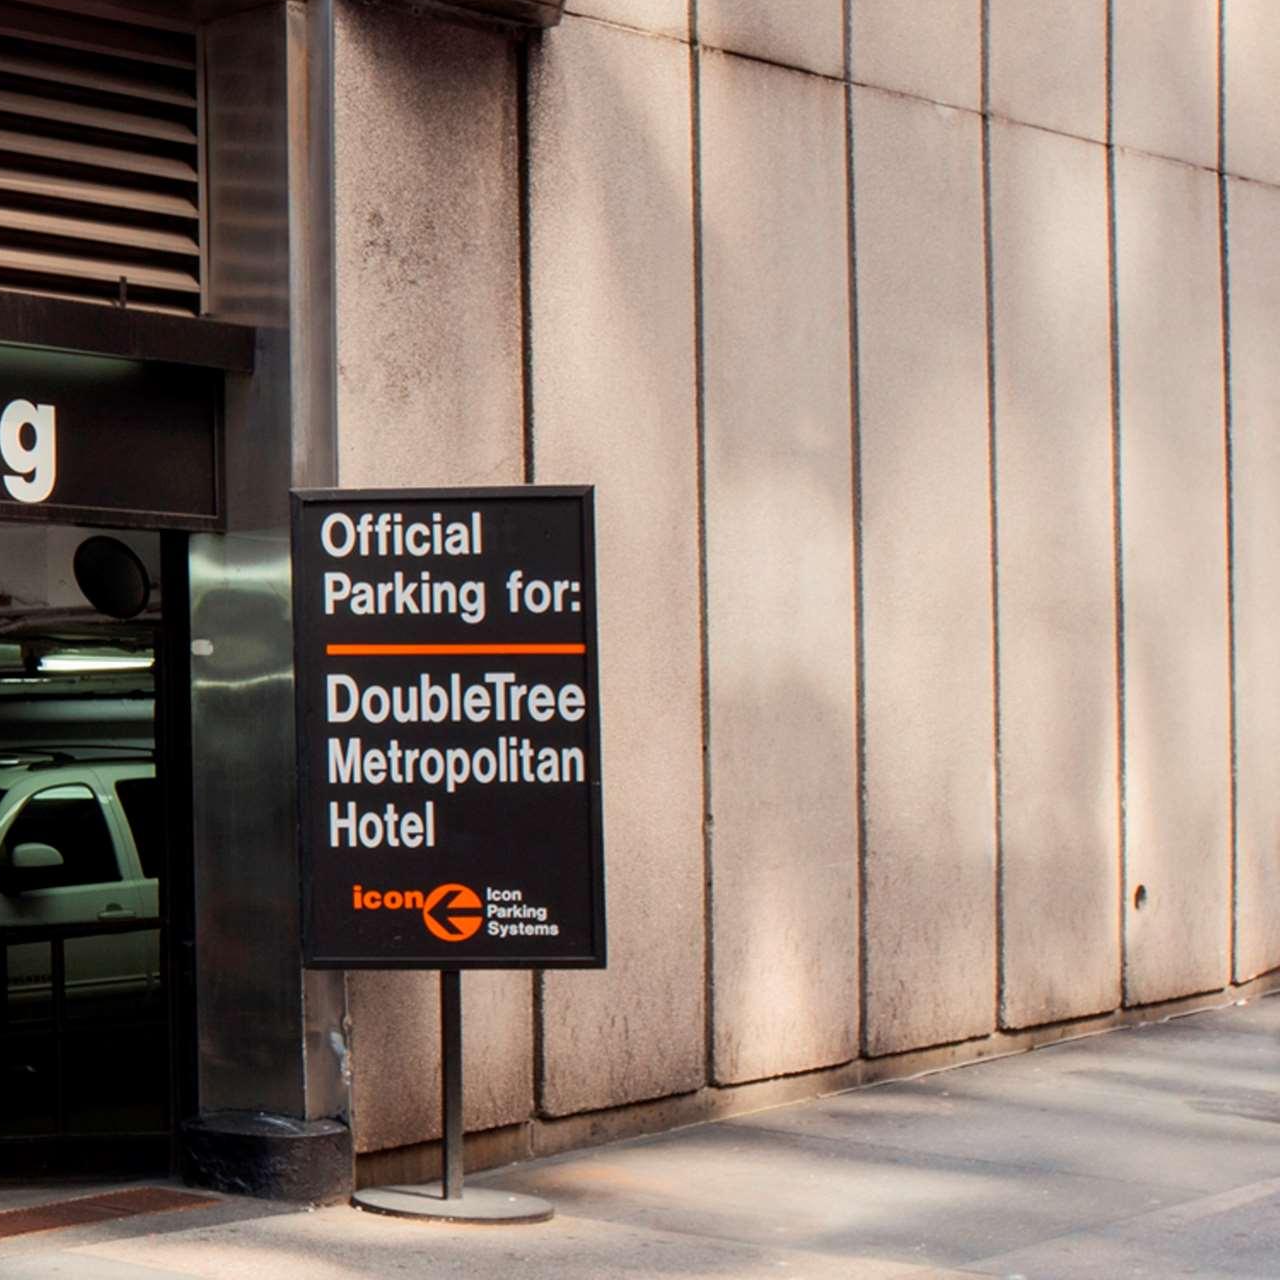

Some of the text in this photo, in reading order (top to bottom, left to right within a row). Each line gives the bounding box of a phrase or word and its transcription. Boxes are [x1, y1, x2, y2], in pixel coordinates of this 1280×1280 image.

[321, 512, 482, 557] Official
[324, 570, 581, 624] Parking for:
[326, 673, 585, 723] DoubleTree
[328, 736, 585, 793] Metropolitan
[329, 800, 435, 848] Hotel
[353, 884, 424, 910] icon
[486, 886, 522, 902] Icon
[486, 903, 548, 923] Parking
[487, 922, 560, 938] Systems
